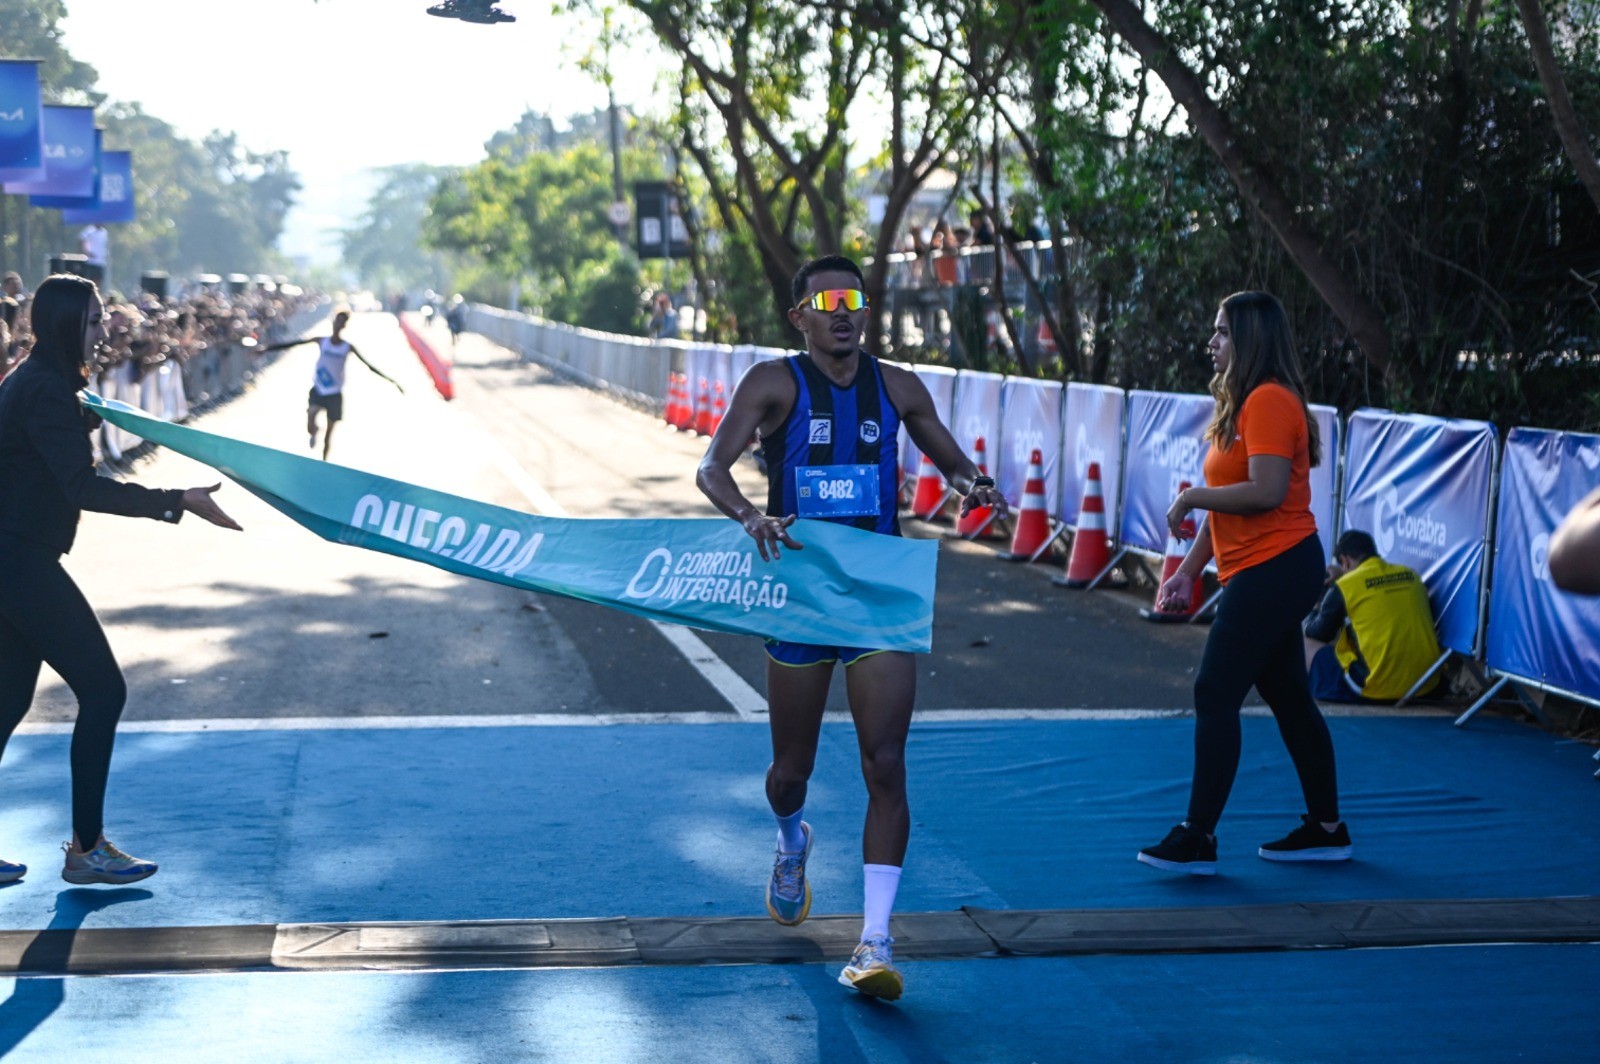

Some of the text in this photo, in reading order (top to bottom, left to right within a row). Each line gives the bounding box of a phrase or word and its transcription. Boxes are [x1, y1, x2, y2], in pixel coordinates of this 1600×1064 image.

[1151, 432, 1199, 473] POWER
[819, 479, 855, 499] 8482
[1397, 501, 1447, 546] Covabra
[674, 552, 752, 577] CORRIDA
[659, 575, 788, 612] INTEGRAÇÃO
